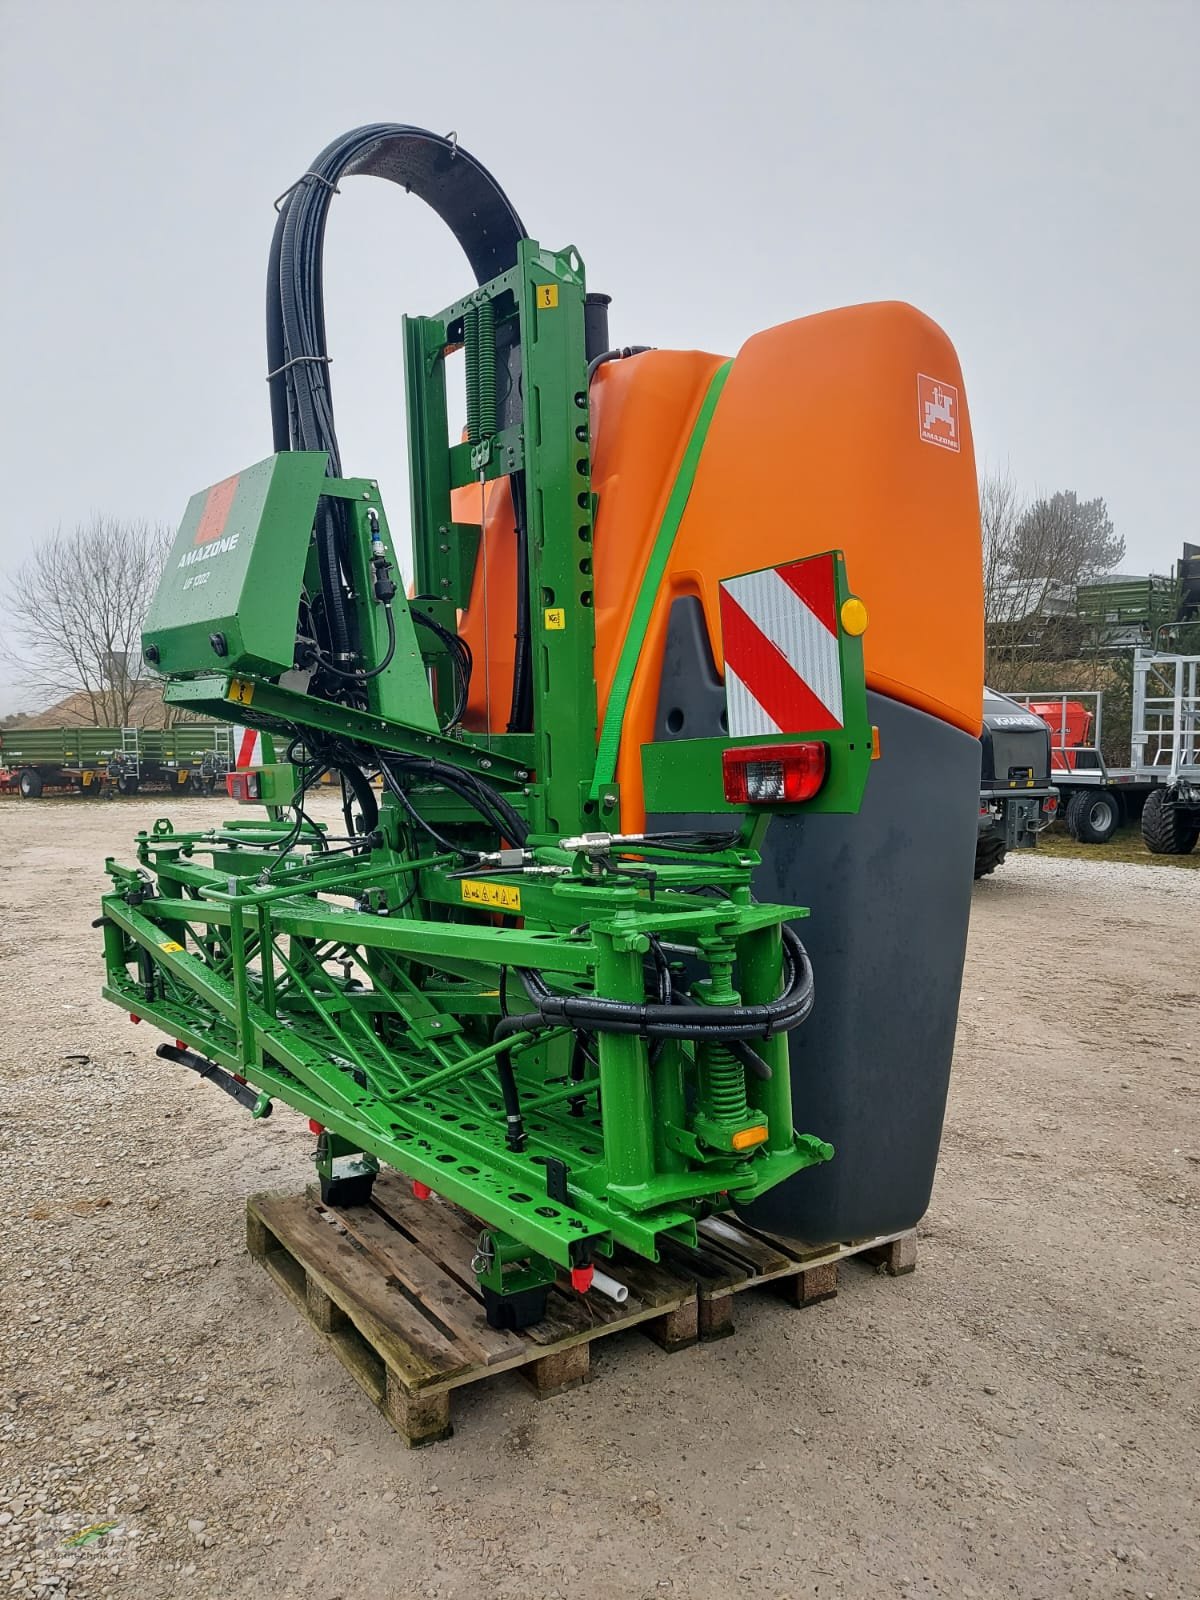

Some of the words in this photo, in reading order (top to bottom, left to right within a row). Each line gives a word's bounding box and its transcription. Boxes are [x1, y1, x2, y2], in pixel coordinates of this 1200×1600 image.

[922, 430, 958, 448] AMAZONE
[178, 533, 240, 569] AMAZONE
[993, 716, 1038, 726] KRAMER
